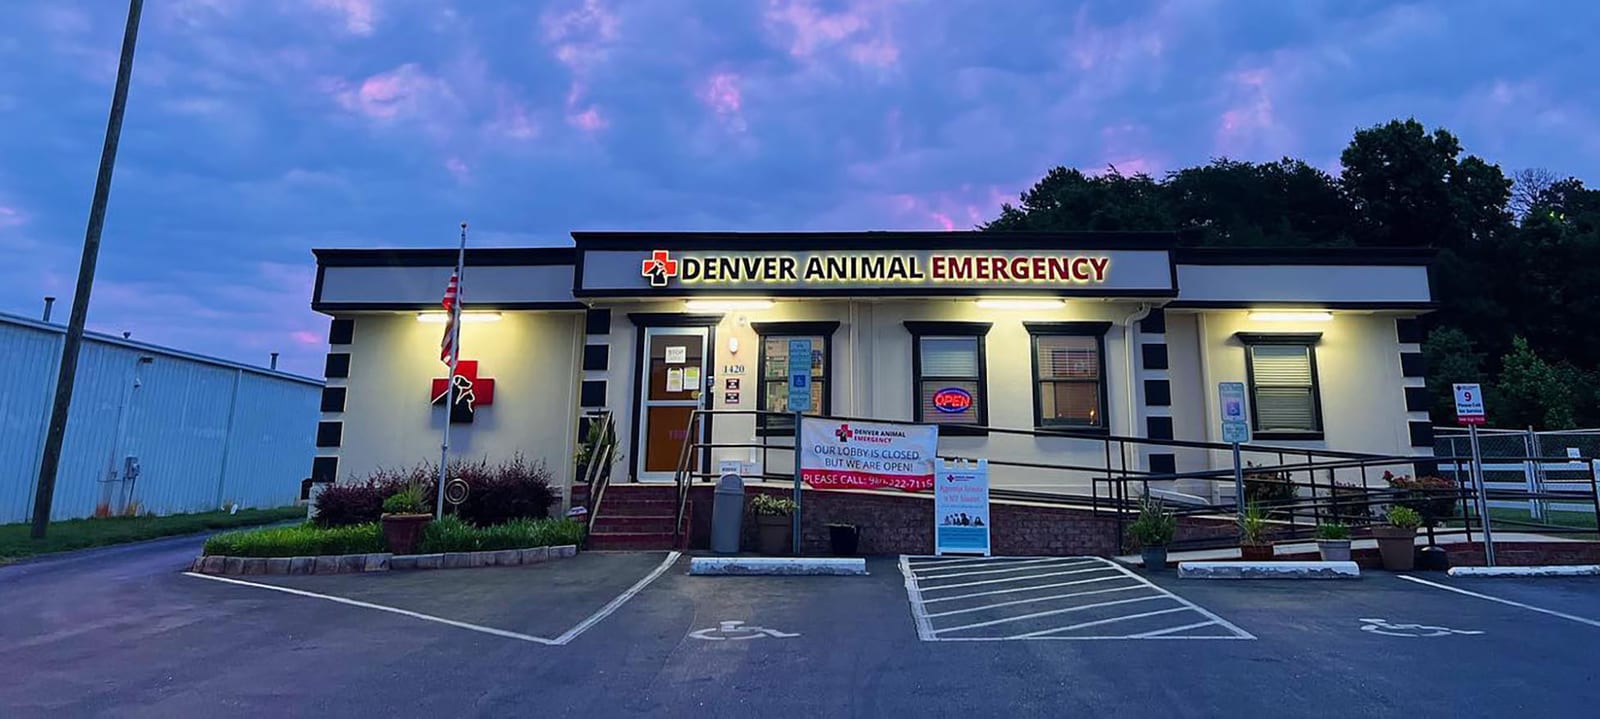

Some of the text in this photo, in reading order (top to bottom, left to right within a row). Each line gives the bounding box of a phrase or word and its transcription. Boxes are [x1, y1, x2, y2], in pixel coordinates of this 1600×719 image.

[681, 256, 1109, 281] DENVER ANIMAL EMERGENCY
[723, 365, 745, 373] 1420
[935, 394, 970, 407] OPEN
[1464, 391, 1472, 401] 9
[854, 429, 879, 437] DENVER
[854, 435, 892, 443] EMERGENCY
[814, 445, 919, 460] OUR LOBBY IS CLOSED
[825, 458, 913, 472] BUT WE ARE OPEN!
[803, 474, 838, 485] PLEASE
[840, 475, 867, 485] CALL:
